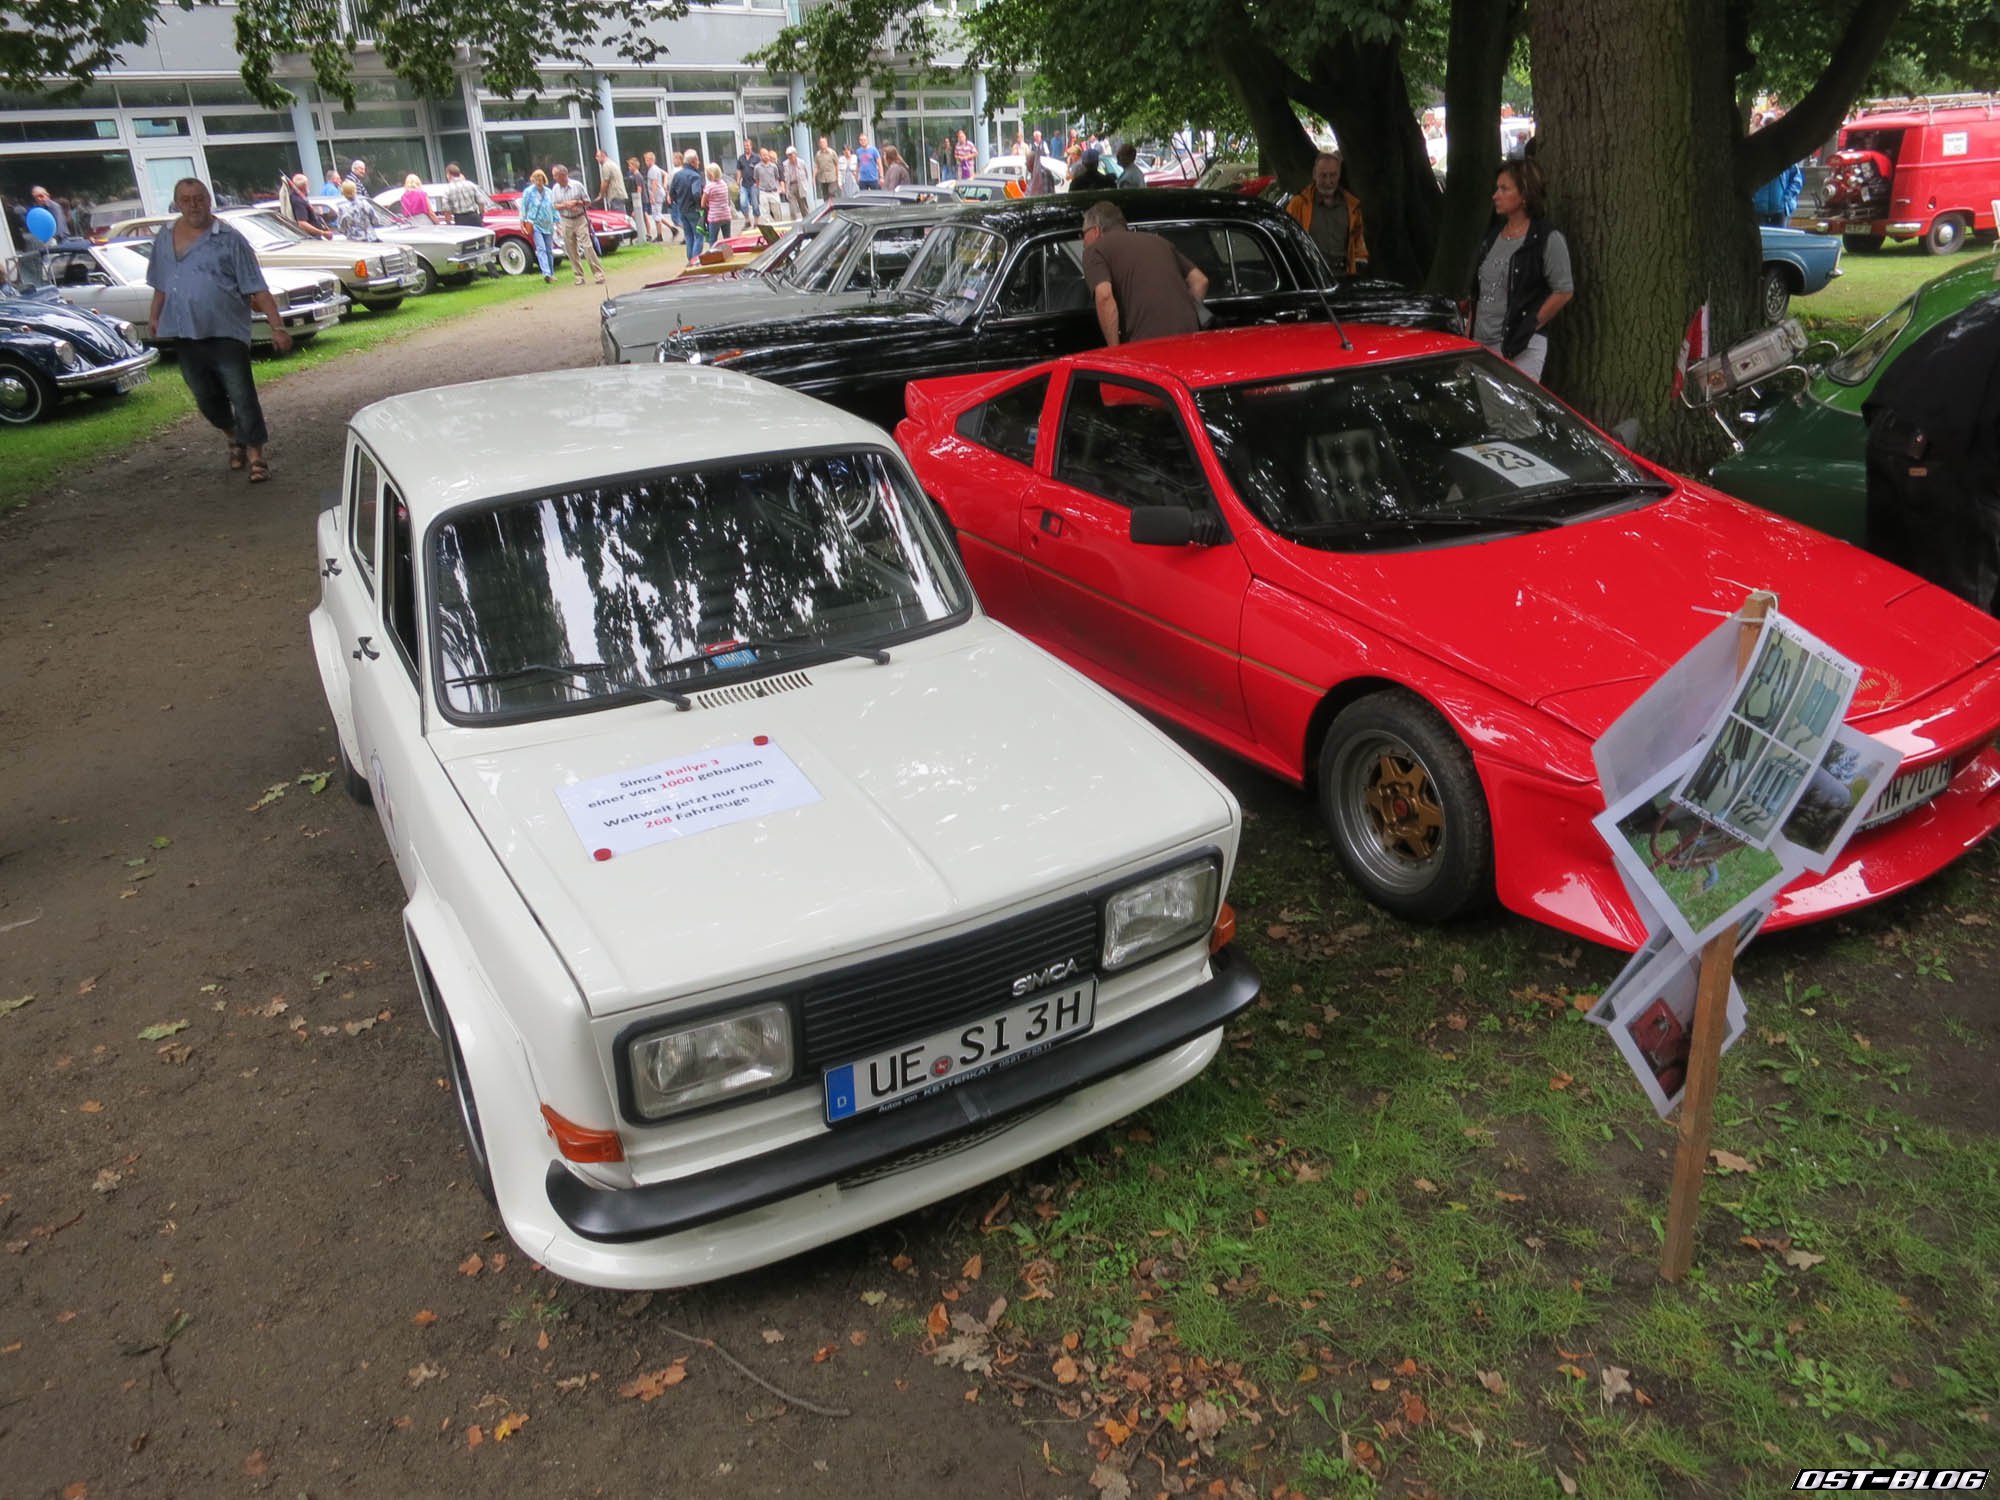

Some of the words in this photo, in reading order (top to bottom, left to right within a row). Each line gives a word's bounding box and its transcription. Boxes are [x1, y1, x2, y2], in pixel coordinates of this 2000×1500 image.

[1481, 450, 1536, 471] 23
[588, 794, 625, 809] einer
[629, 786, 657, 797] von
[661, 775, 695, 790] 1000
[697, 758, 763, 781] gebauten
[619, 773, 663, 789] Simca
[664, 762, 708, 777] Rallye
[711, 758, 720, 766] 3
[603, 804, 673, 828] Weltweit
[675, 795, 709, 810] jetzt
[711, 788, 737, 799] nur
[740, 777, 775, 792] noch
[644, 815, 673, 829] 268
[675, 795, 750, 821] Fahrzeuge
[1012, 957, 1079, 997] SIMCA
[836, 1095, 847, 1108] D
[869, 1045, 927, 1097] UE
[960, 1016, 1010, 1066] SI
[1025, 990, 1081, 1042] 3H
